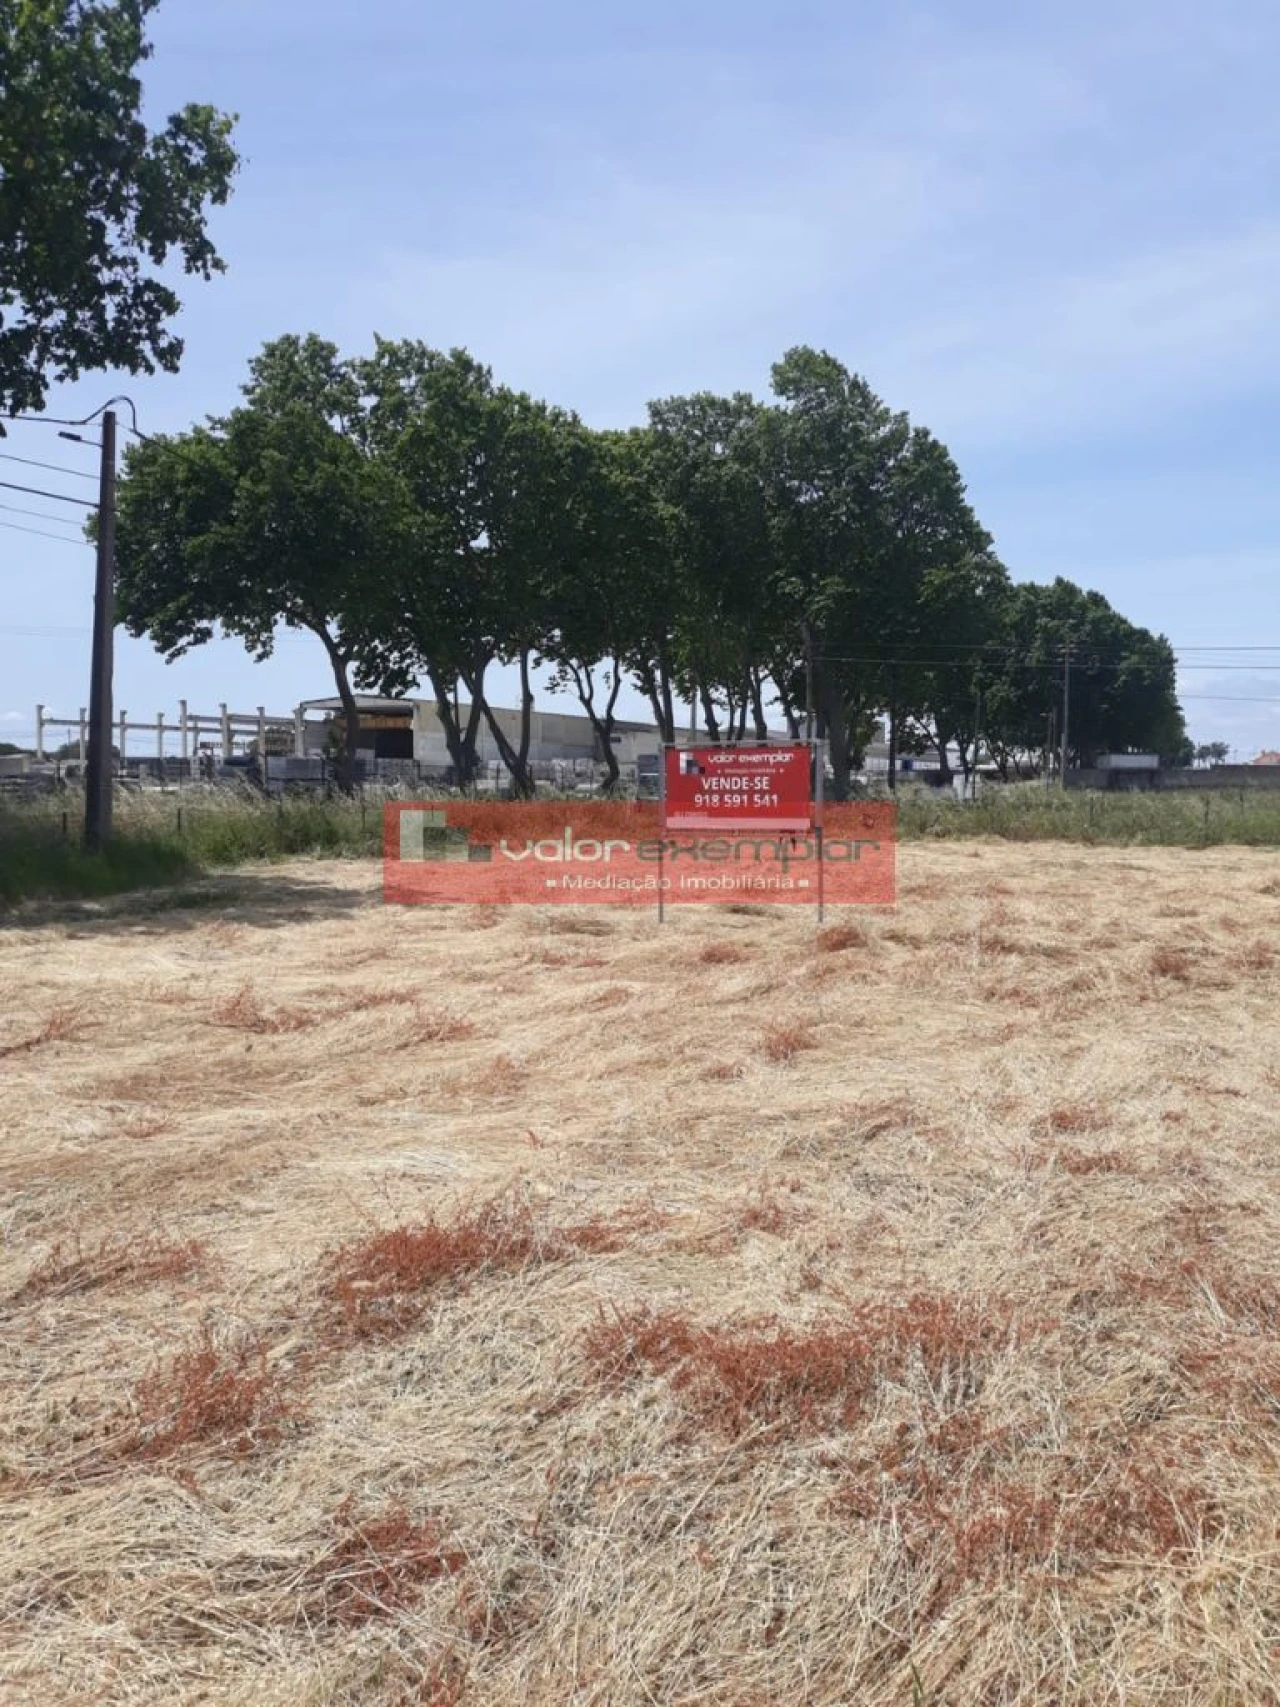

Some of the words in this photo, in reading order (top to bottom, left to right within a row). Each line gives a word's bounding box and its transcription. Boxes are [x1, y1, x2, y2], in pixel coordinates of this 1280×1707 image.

[738, 750, 794, 765] exemplar
[702, 777, 770, 790] VENDE-SE
[694, 794, 720, 808] 918
[724, 794, 748, 808] 591
[753, 794, 778, 808] 541
